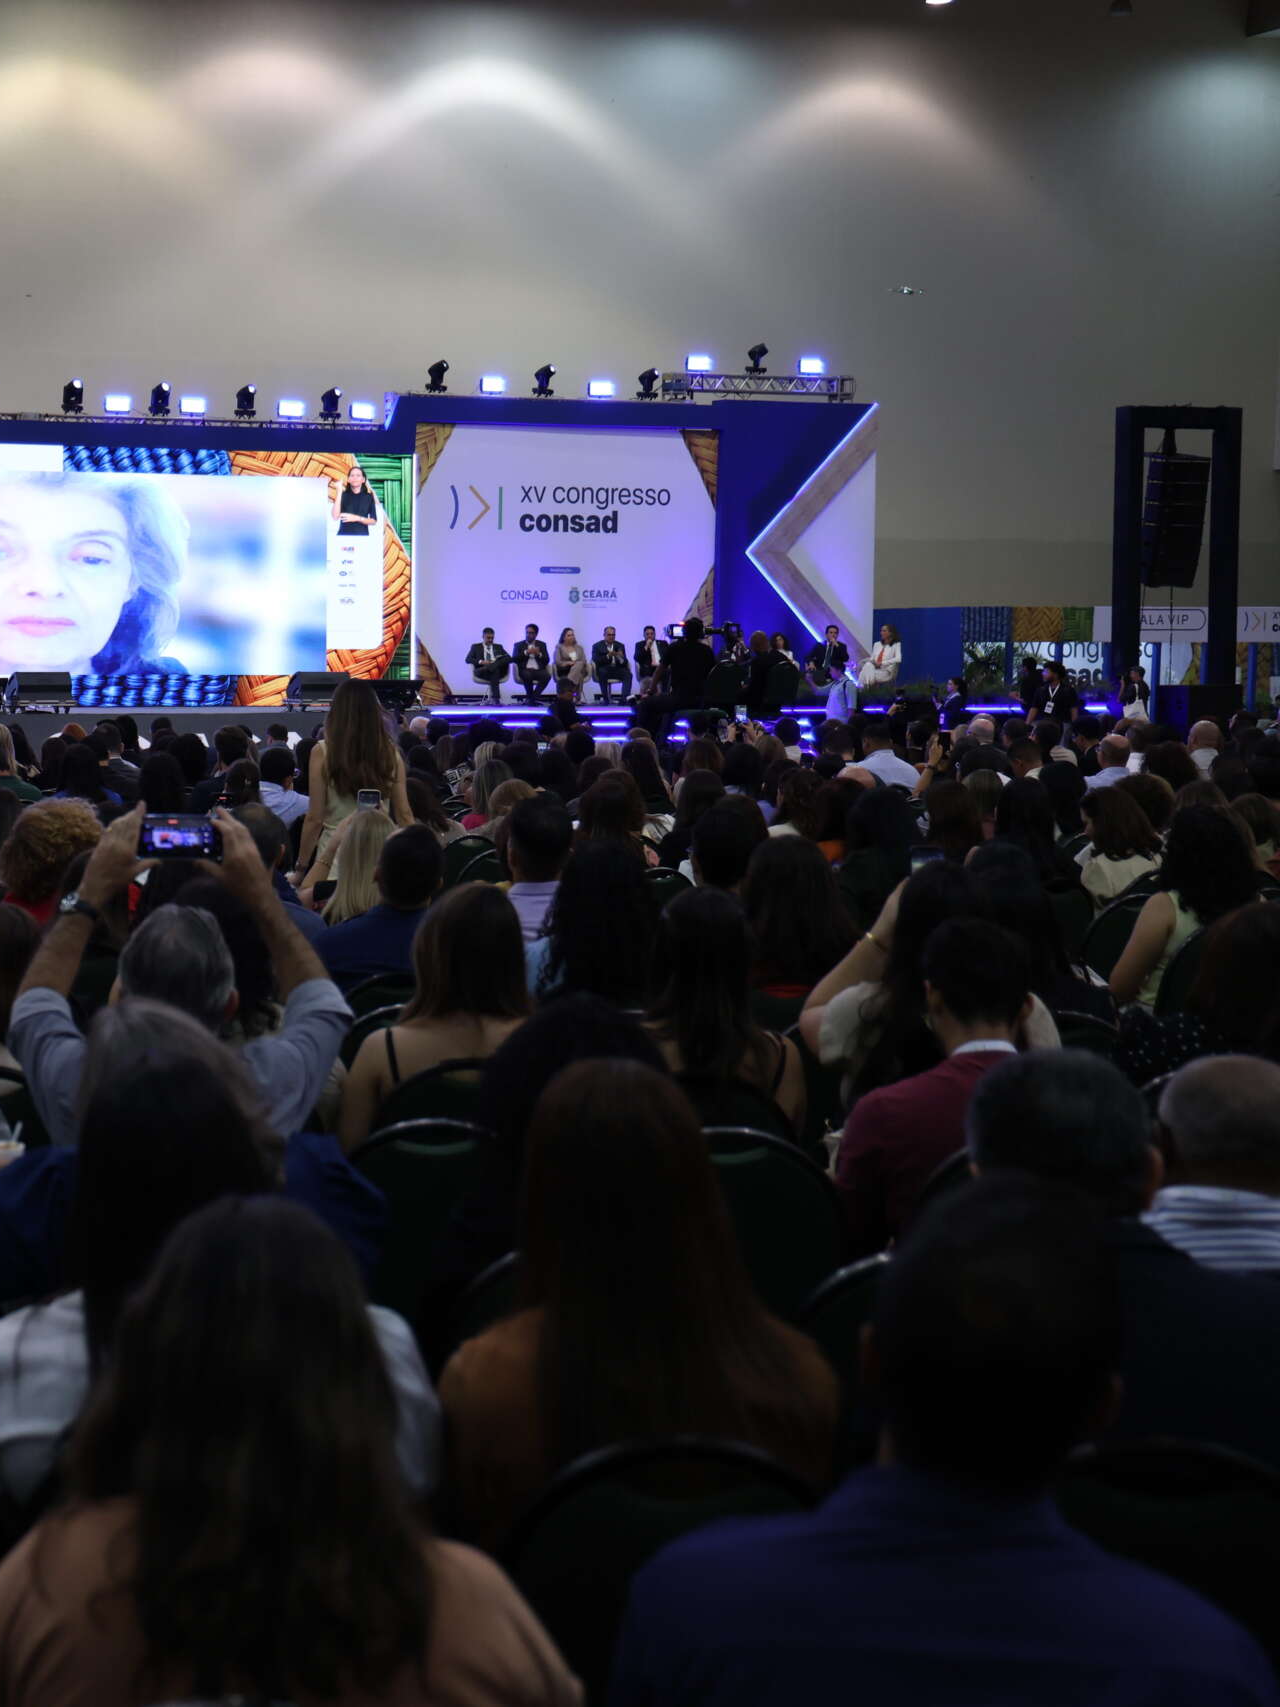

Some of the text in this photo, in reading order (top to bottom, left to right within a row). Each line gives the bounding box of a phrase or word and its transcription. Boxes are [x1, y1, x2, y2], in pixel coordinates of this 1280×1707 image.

[520, 485, 671, 510] XV congresso
[520, 511, 618, 534] consad
[500, 590, 549, 601] CONSAD
[582, 588, 617, 598] CEARÁ
[1140, 614, 1189, 625] ALA VIP
